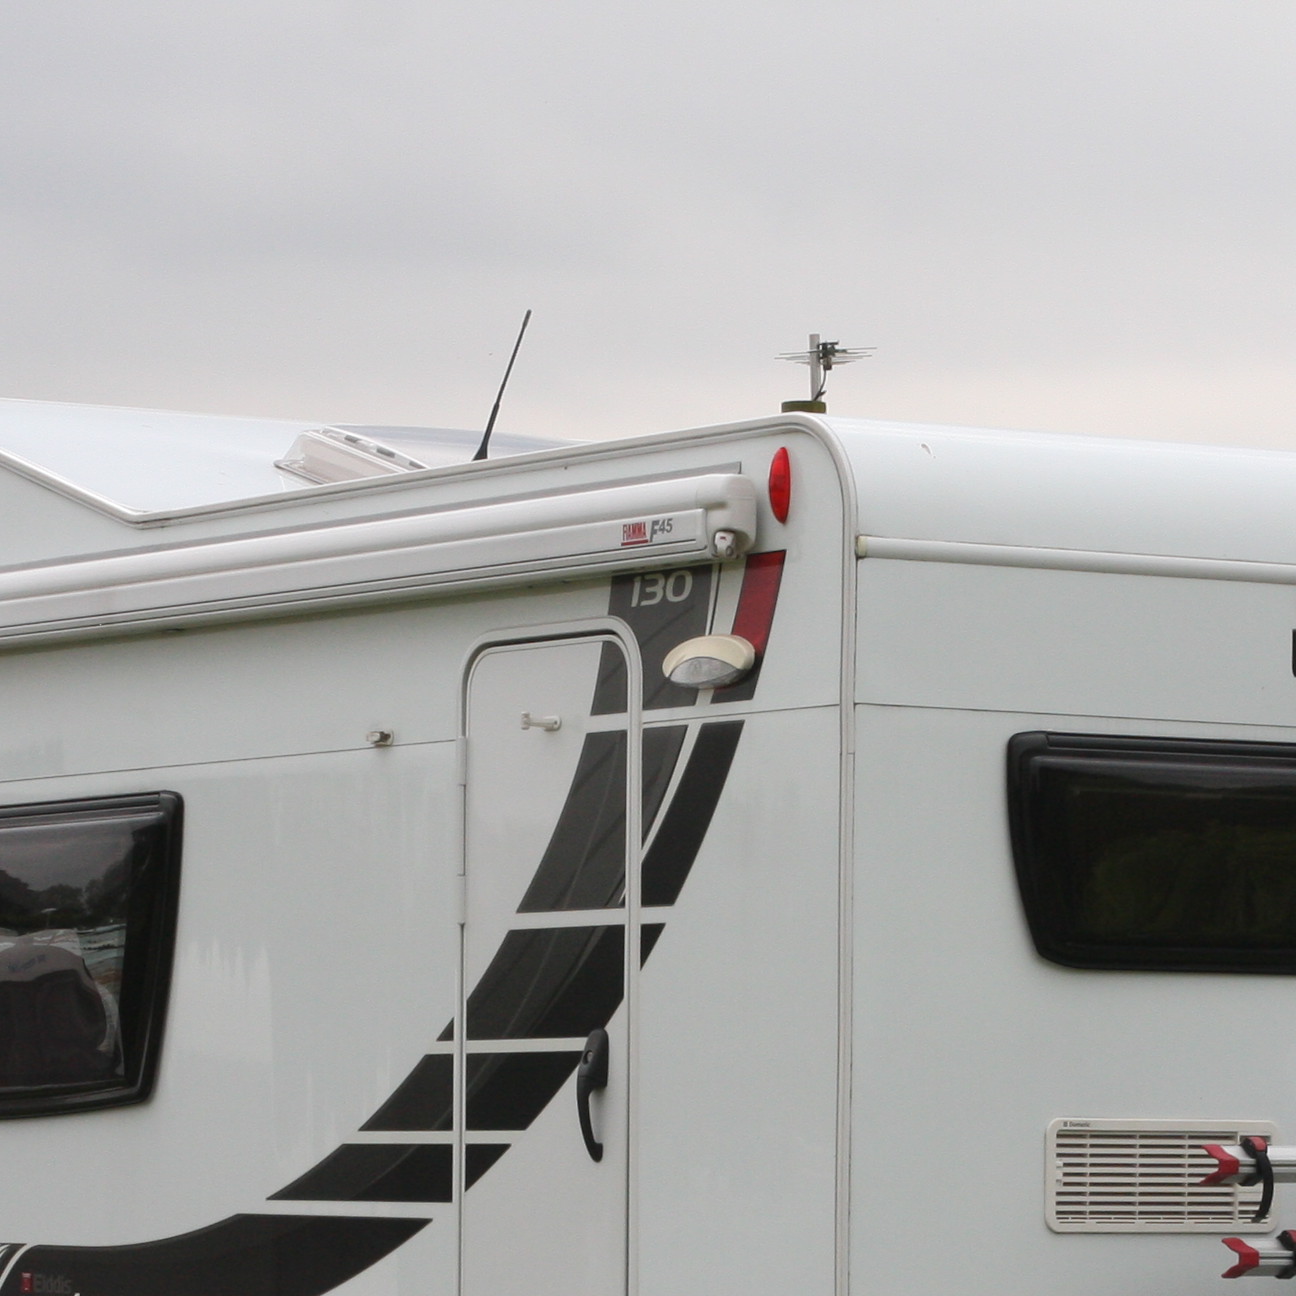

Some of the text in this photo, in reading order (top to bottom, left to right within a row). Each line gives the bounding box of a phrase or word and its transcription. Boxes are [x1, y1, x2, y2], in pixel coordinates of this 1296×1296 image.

[622, 518, 673, 542] FIAMMA F45
[630, 570, 693, 608] 130
